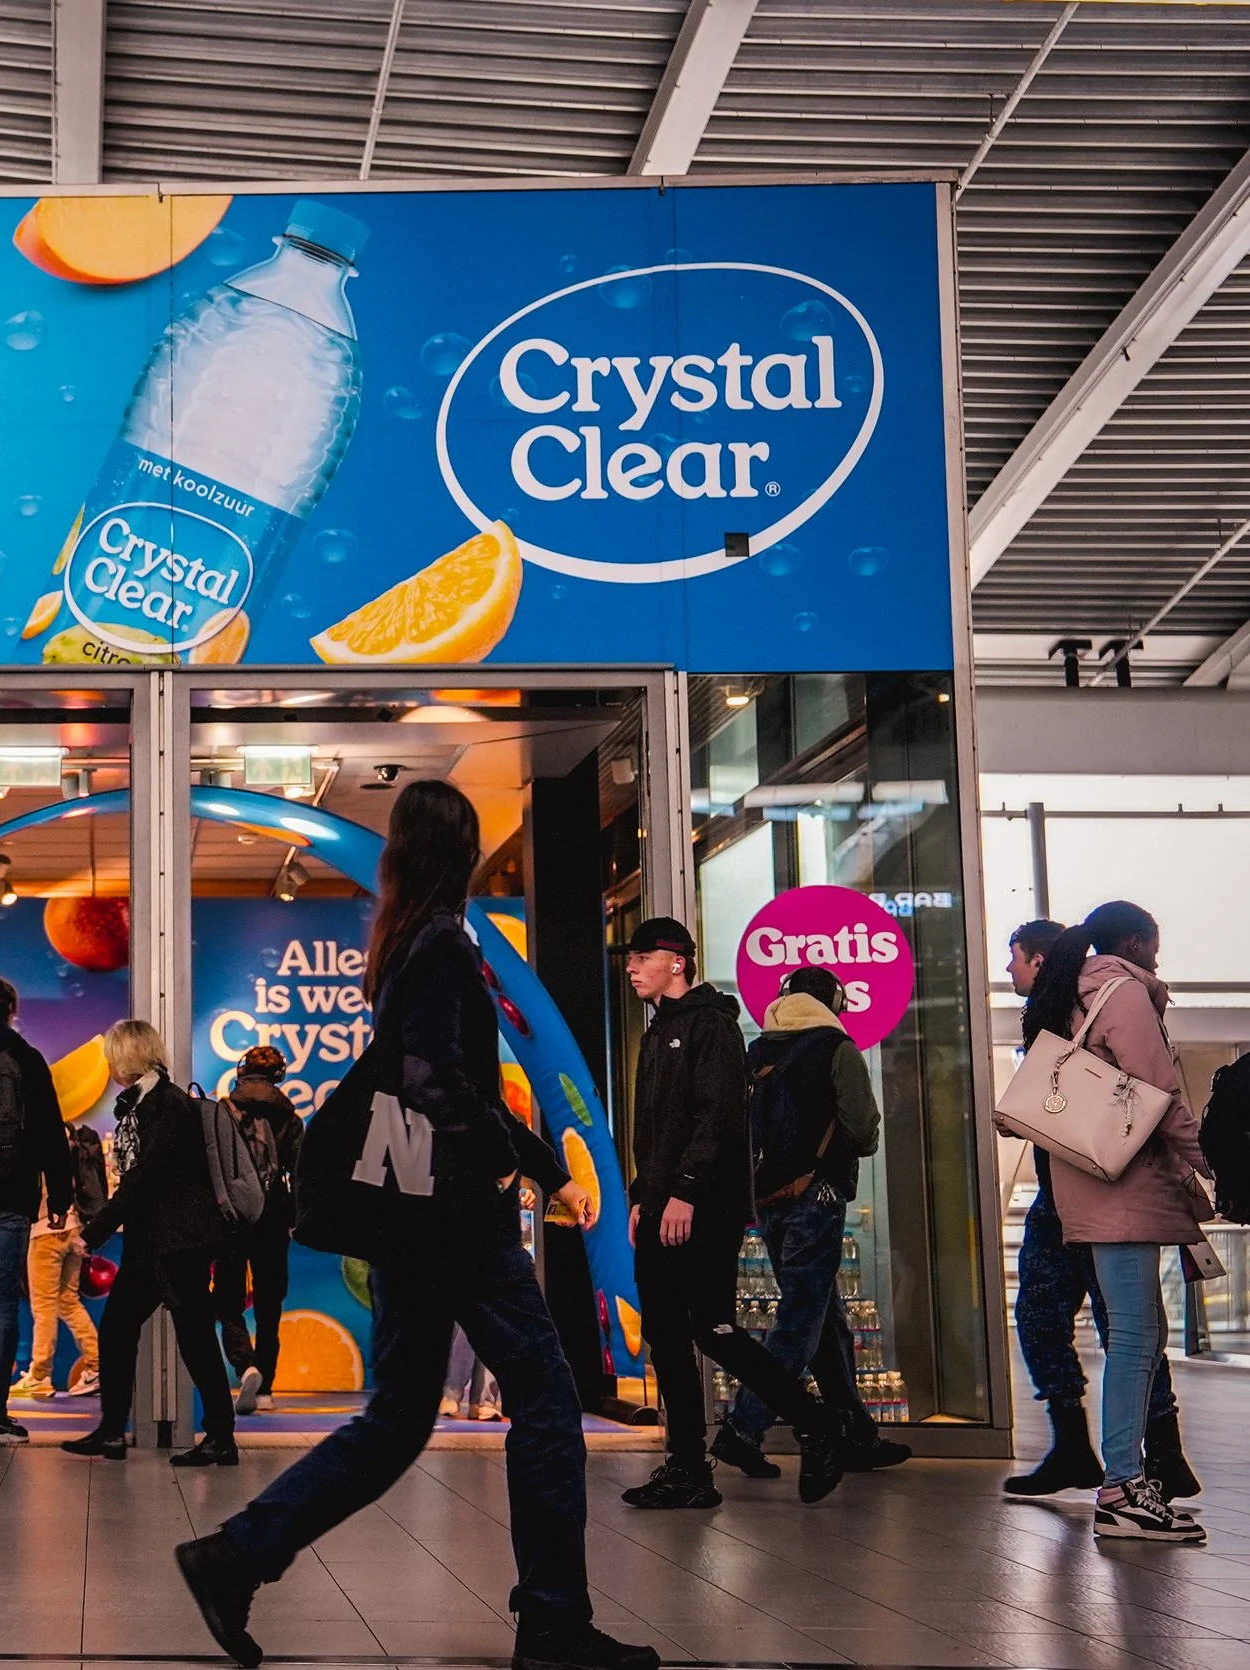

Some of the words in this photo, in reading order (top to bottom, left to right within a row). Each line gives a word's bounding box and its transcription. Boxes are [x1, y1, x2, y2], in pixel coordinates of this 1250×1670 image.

[499, 335, 842, 432] Crystal
[138, 459, 171, 482] met
[172, 470, 255, 517] koolzuur
[100, 518, 239, 604] Crystal
[277, 939, 368, 977] Alle
[746, 923, 899, 966] Gratis
[255, 977, 291, 1013] is
[297, 985, 373, 1014] we
[210, 1010, 374, 1074] Cryst
[351, 1091, 435, 1196] N
